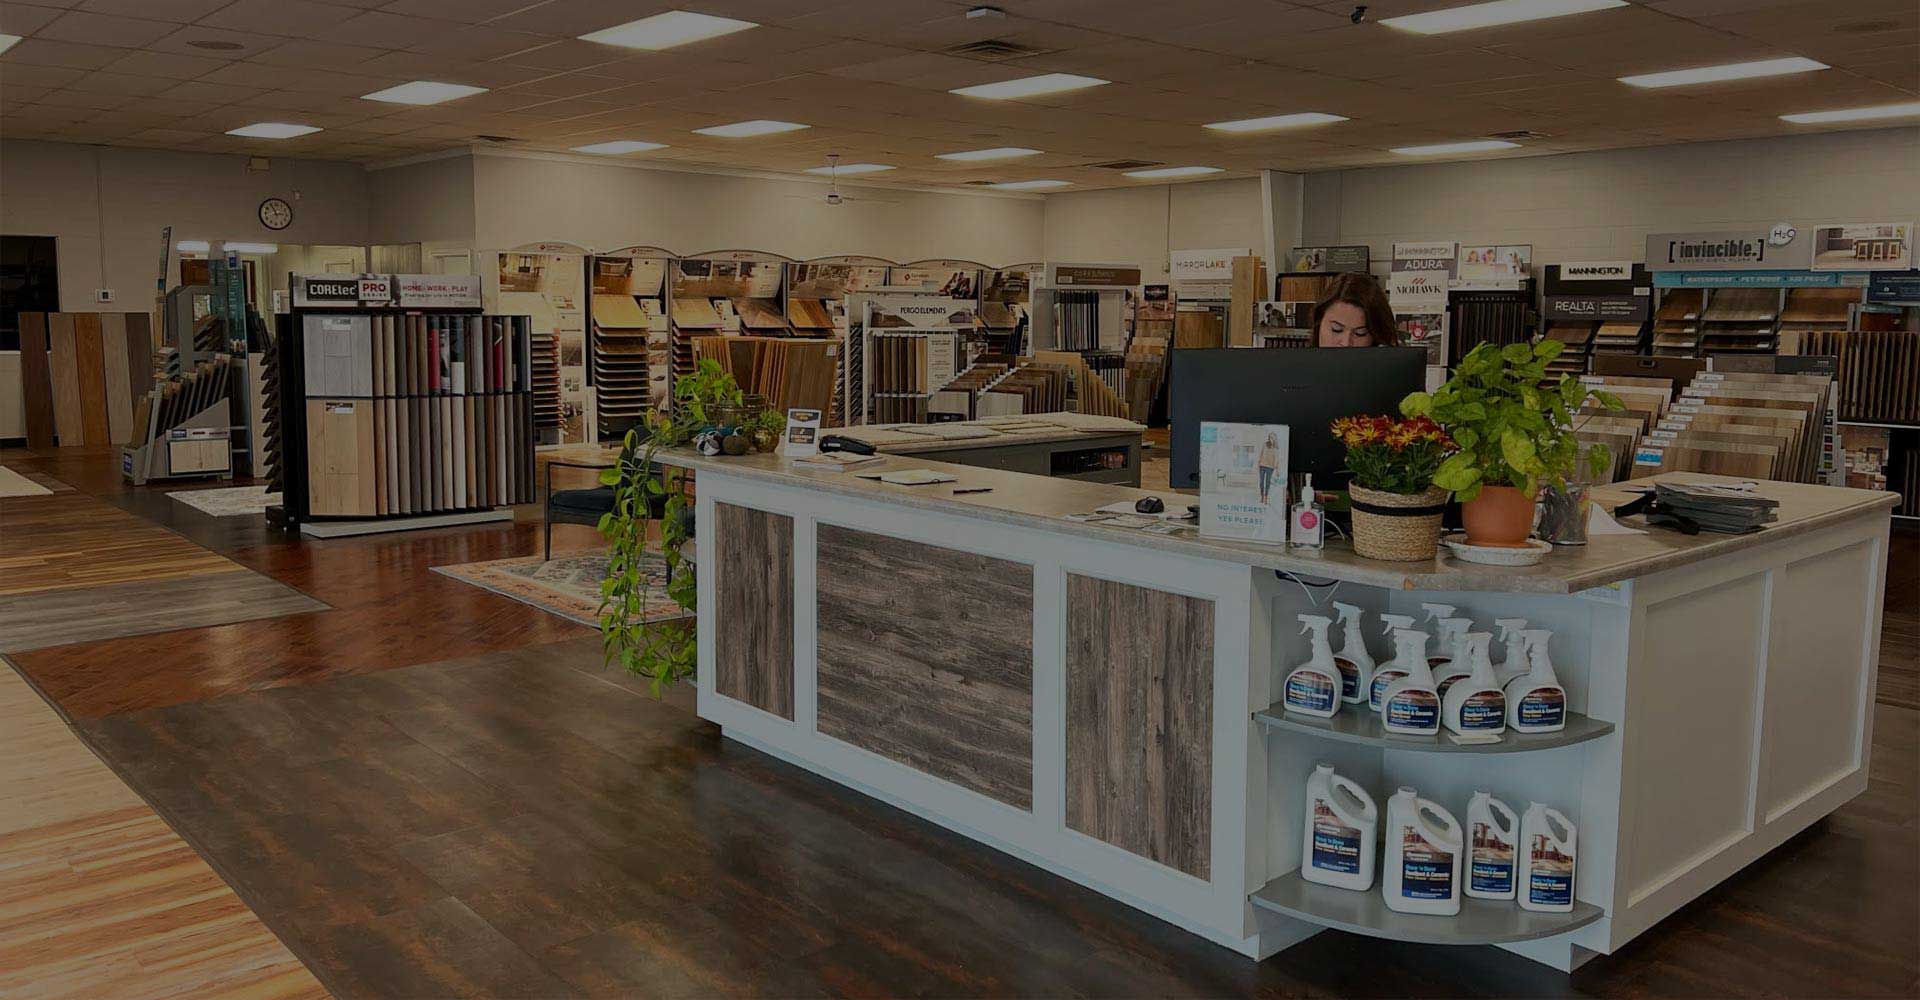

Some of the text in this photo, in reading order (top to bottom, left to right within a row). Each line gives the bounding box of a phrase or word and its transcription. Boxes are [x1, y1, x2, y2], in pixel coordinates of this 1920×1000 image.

[1404, 260, 1444, 270] ADURA
[1568, 267, 1623, 275] MANNINGTON
[362, 283, 386, 292] PRO
[1396, 286, 1441, 294] MOHAWK
[1555, 301, 1595, 311] REALTA
[1217, 503, 1267, 513] NO INTEREST
